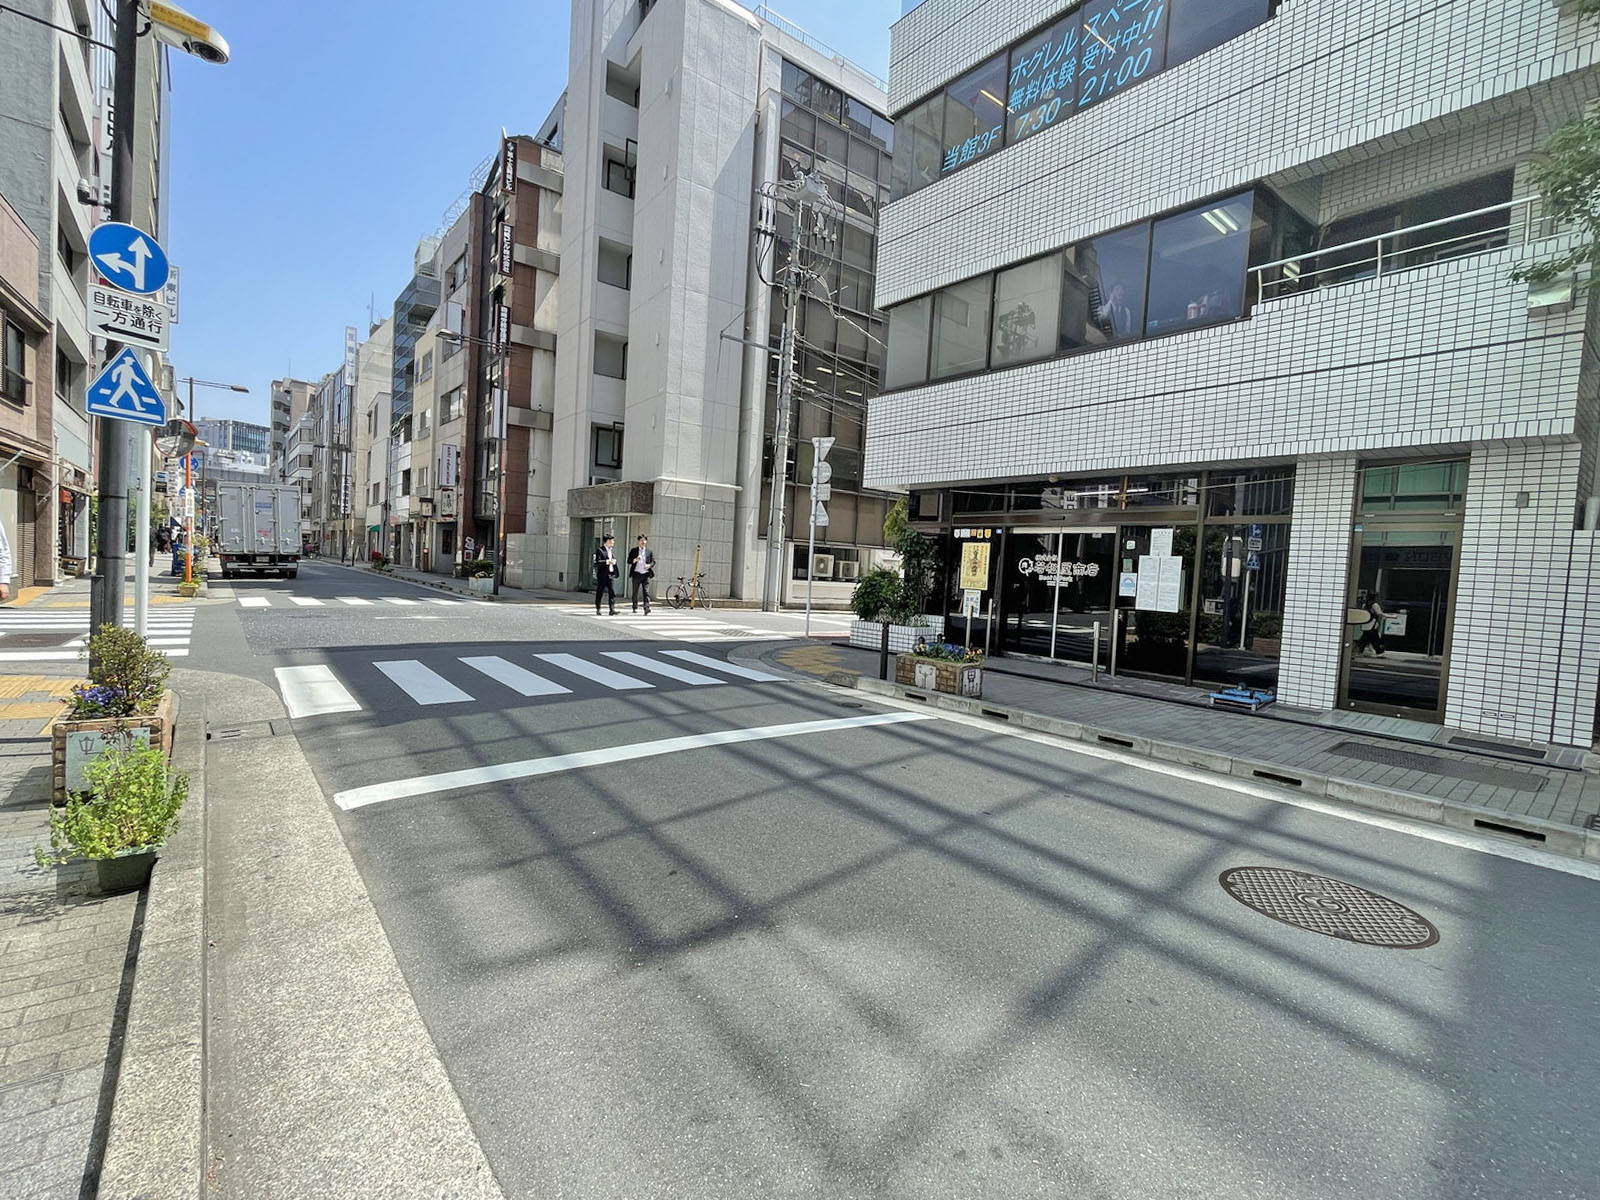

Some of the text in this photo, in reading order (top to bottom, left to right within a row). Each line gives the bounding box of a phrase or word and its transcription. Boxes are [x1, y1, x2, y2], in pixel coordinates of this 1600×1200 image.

[1009, 27, 1079, 86] ホグレル
[1007, 56, 1077, 116] 無料体験
[942, 124, 1002, 171] 当館3F
[93, 309, 163, 335] 一方通行
[94, 291, 163, 321] 自転車を除く
